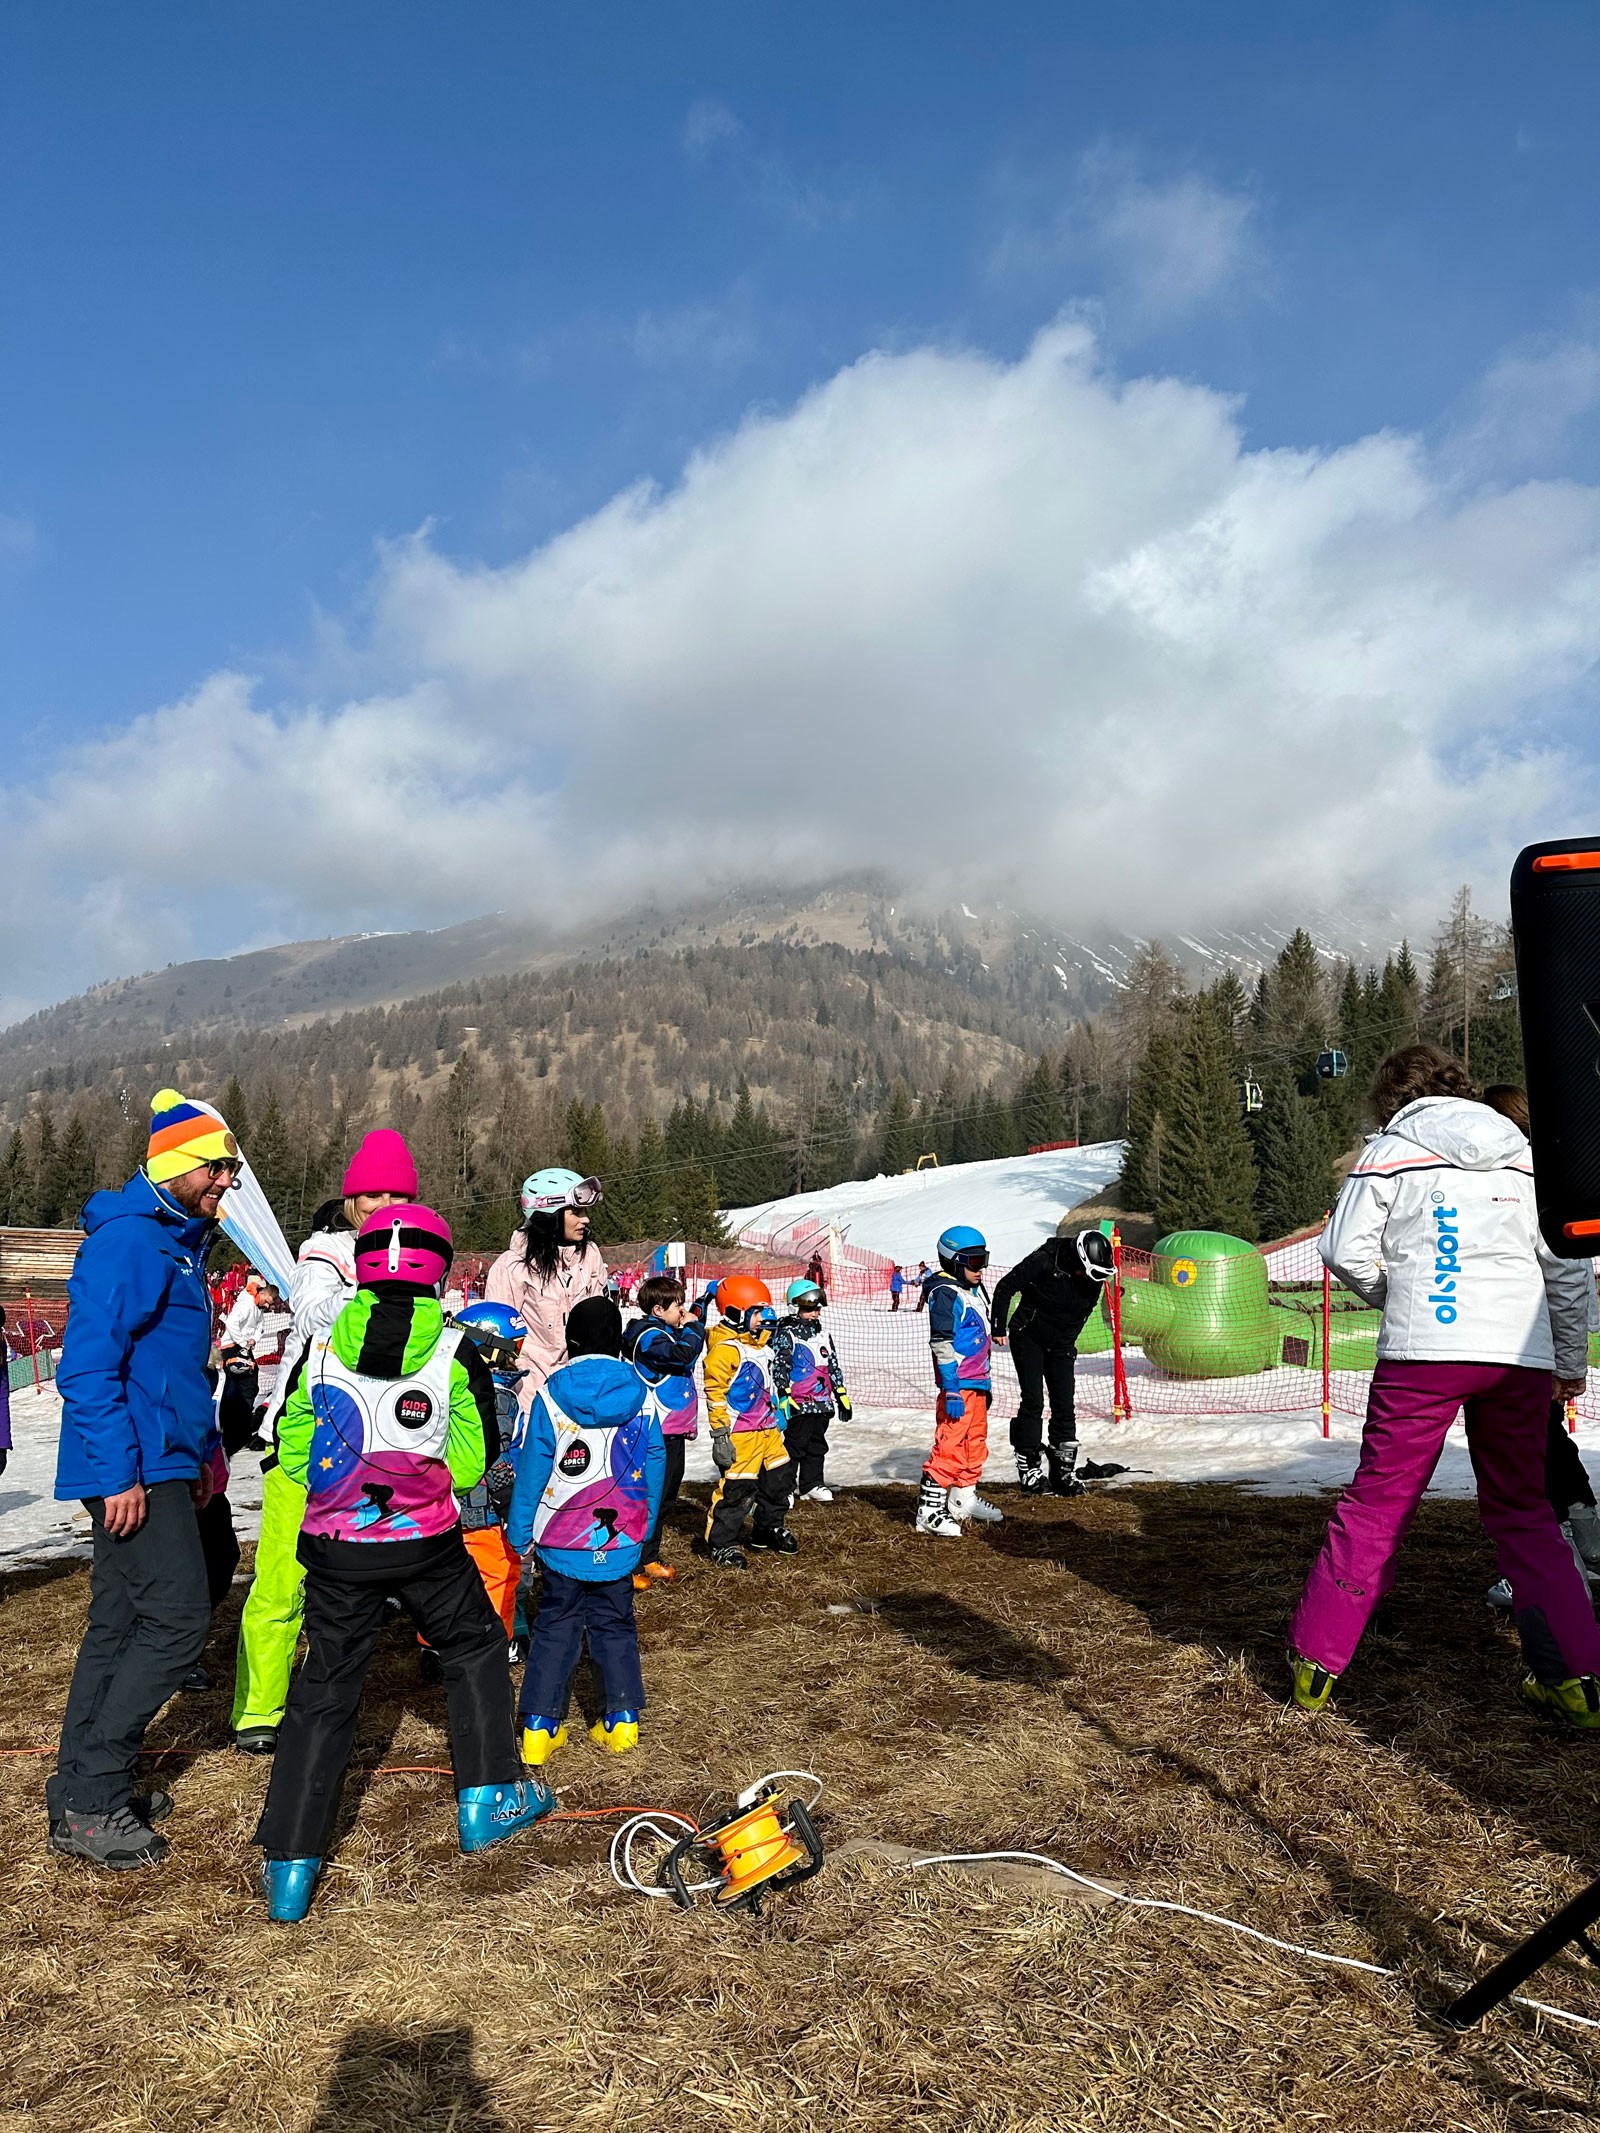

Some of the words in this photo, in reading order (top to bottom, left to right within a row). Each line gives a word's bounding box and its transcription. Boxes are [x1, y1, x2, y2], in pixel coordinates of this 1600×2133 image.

[1427, 1206, 1462, 1325] olsport
[402, 1400, 428, 1412] KIDS
[400, 1409, 426, 1419] SPACE
[563, 1458, 586, 1466] SPACE
